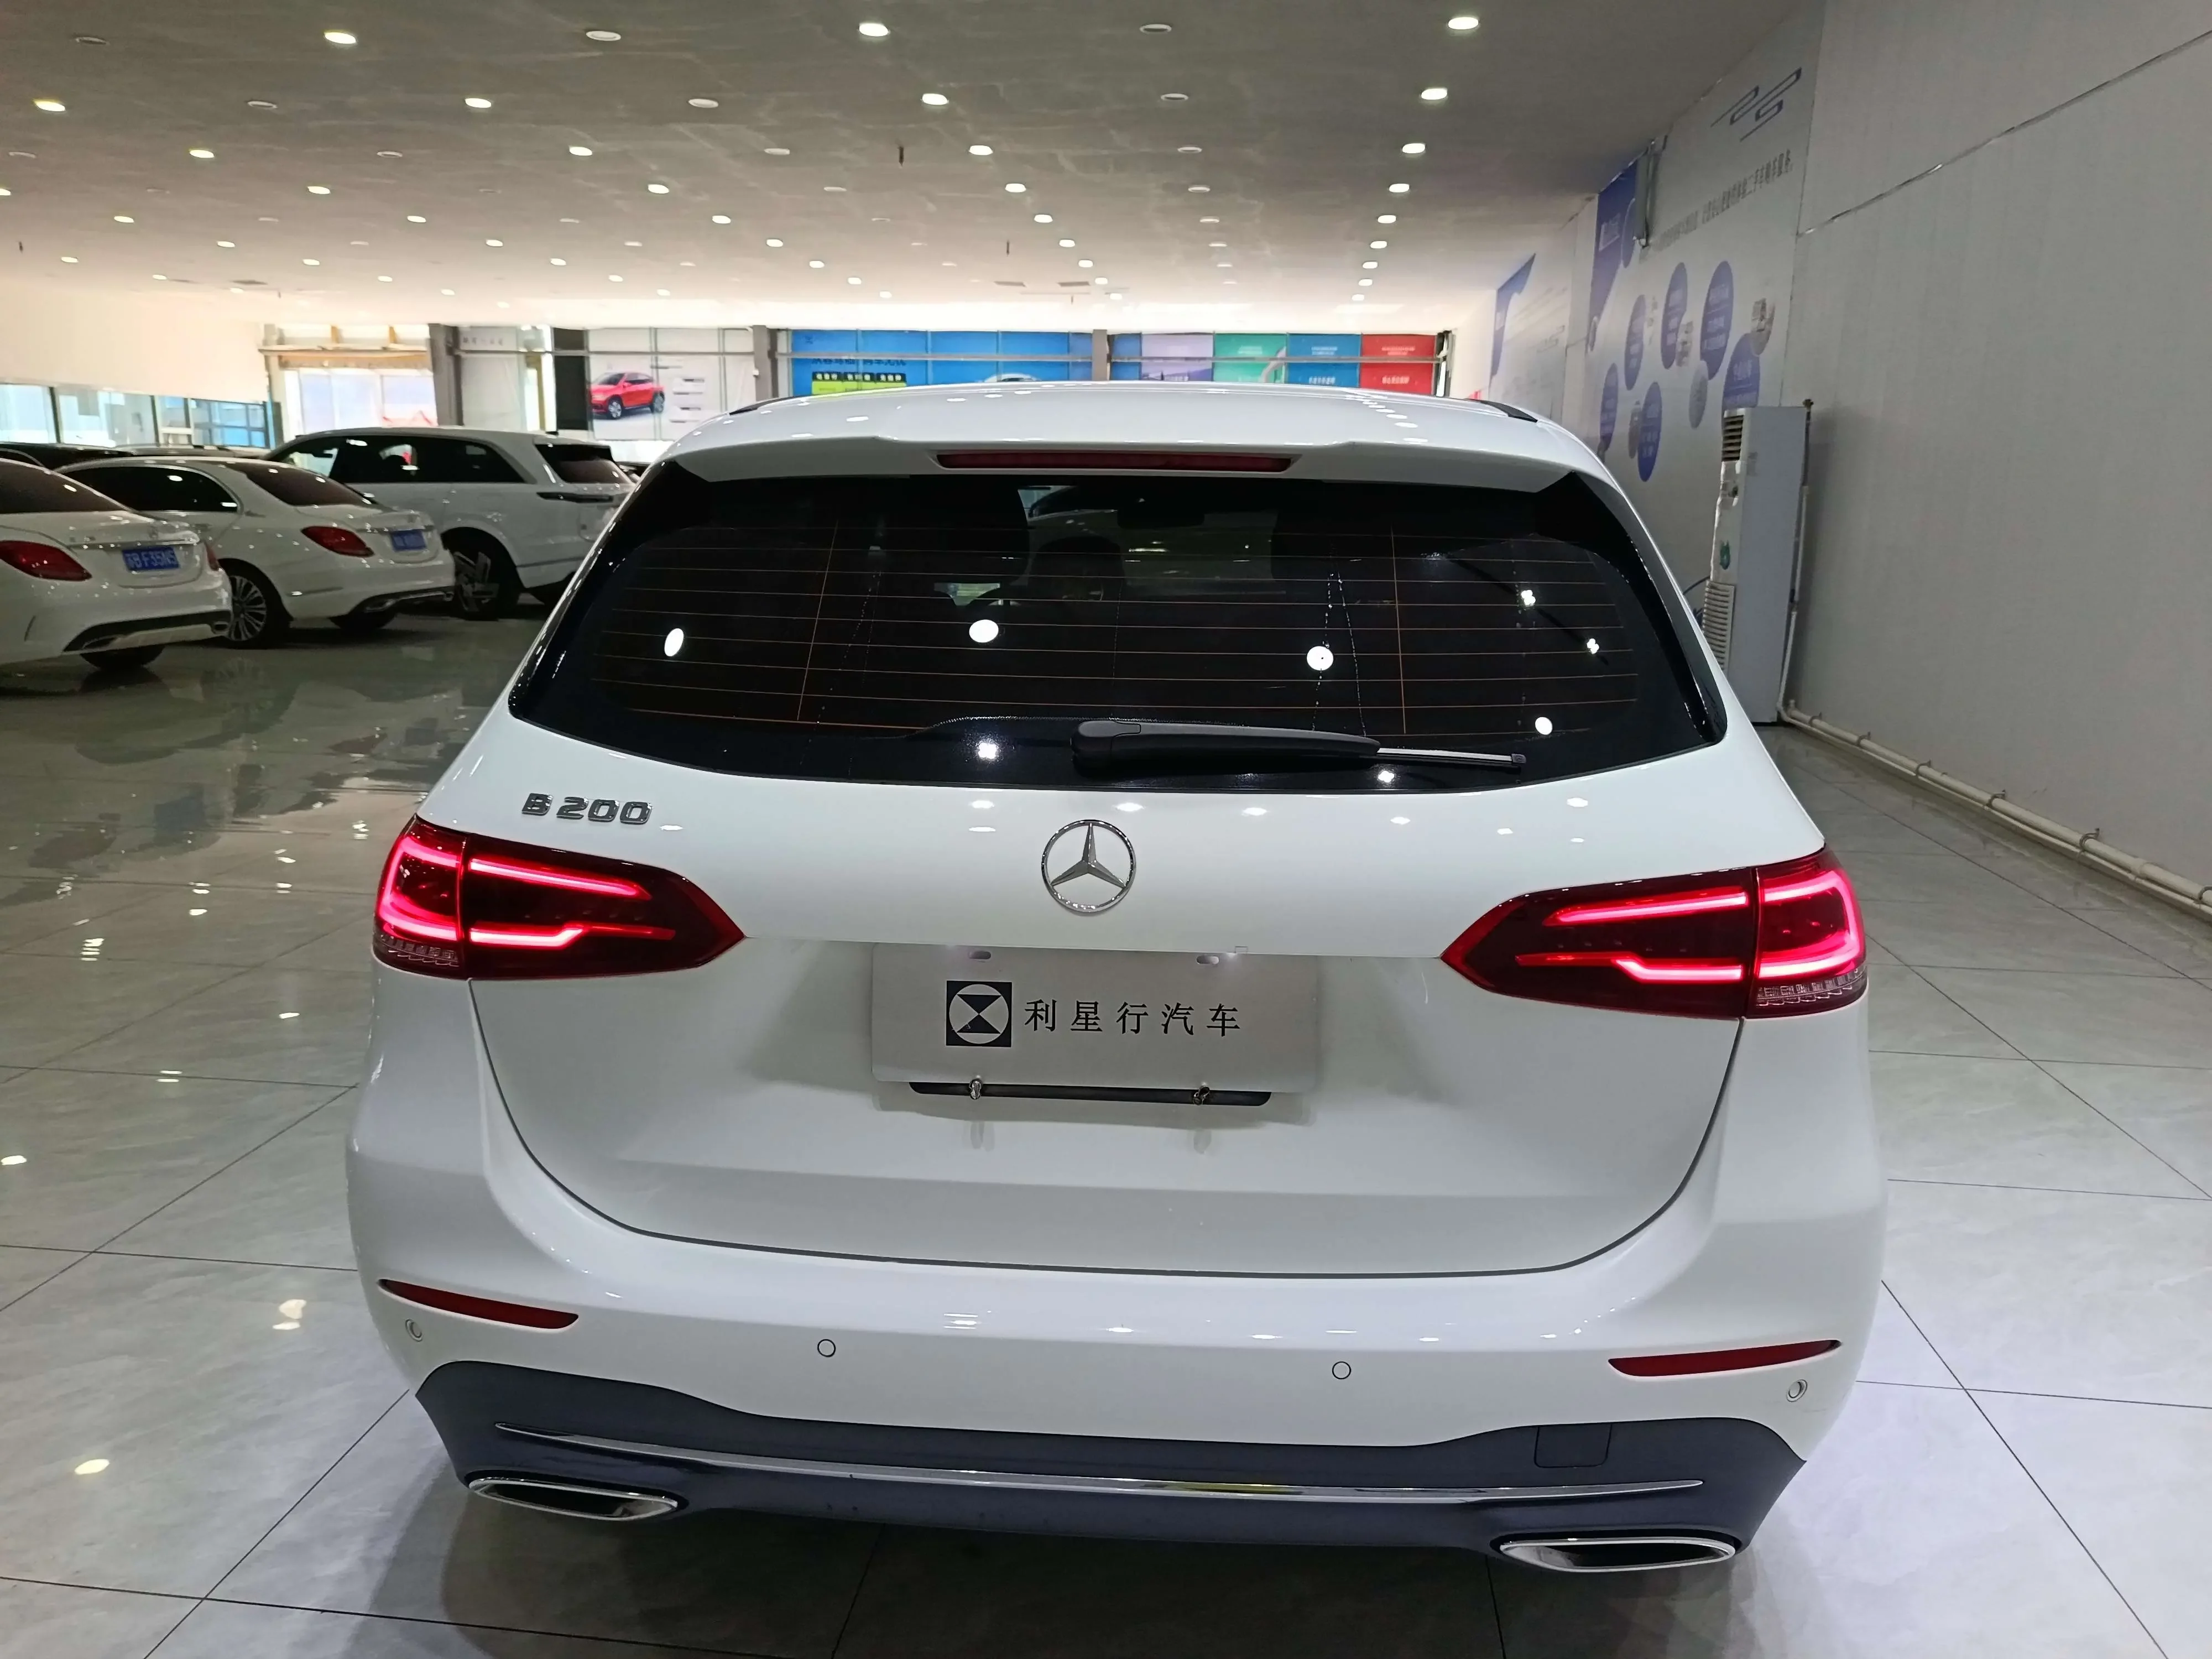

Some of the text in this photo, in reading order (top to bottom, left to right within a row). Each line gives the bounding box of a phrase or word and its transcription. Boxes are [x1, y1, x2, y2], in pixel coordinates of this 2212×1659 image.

[521, 792, 653, 825] B 200
[1024, 999, 1240, 1037] 利星行汽车
